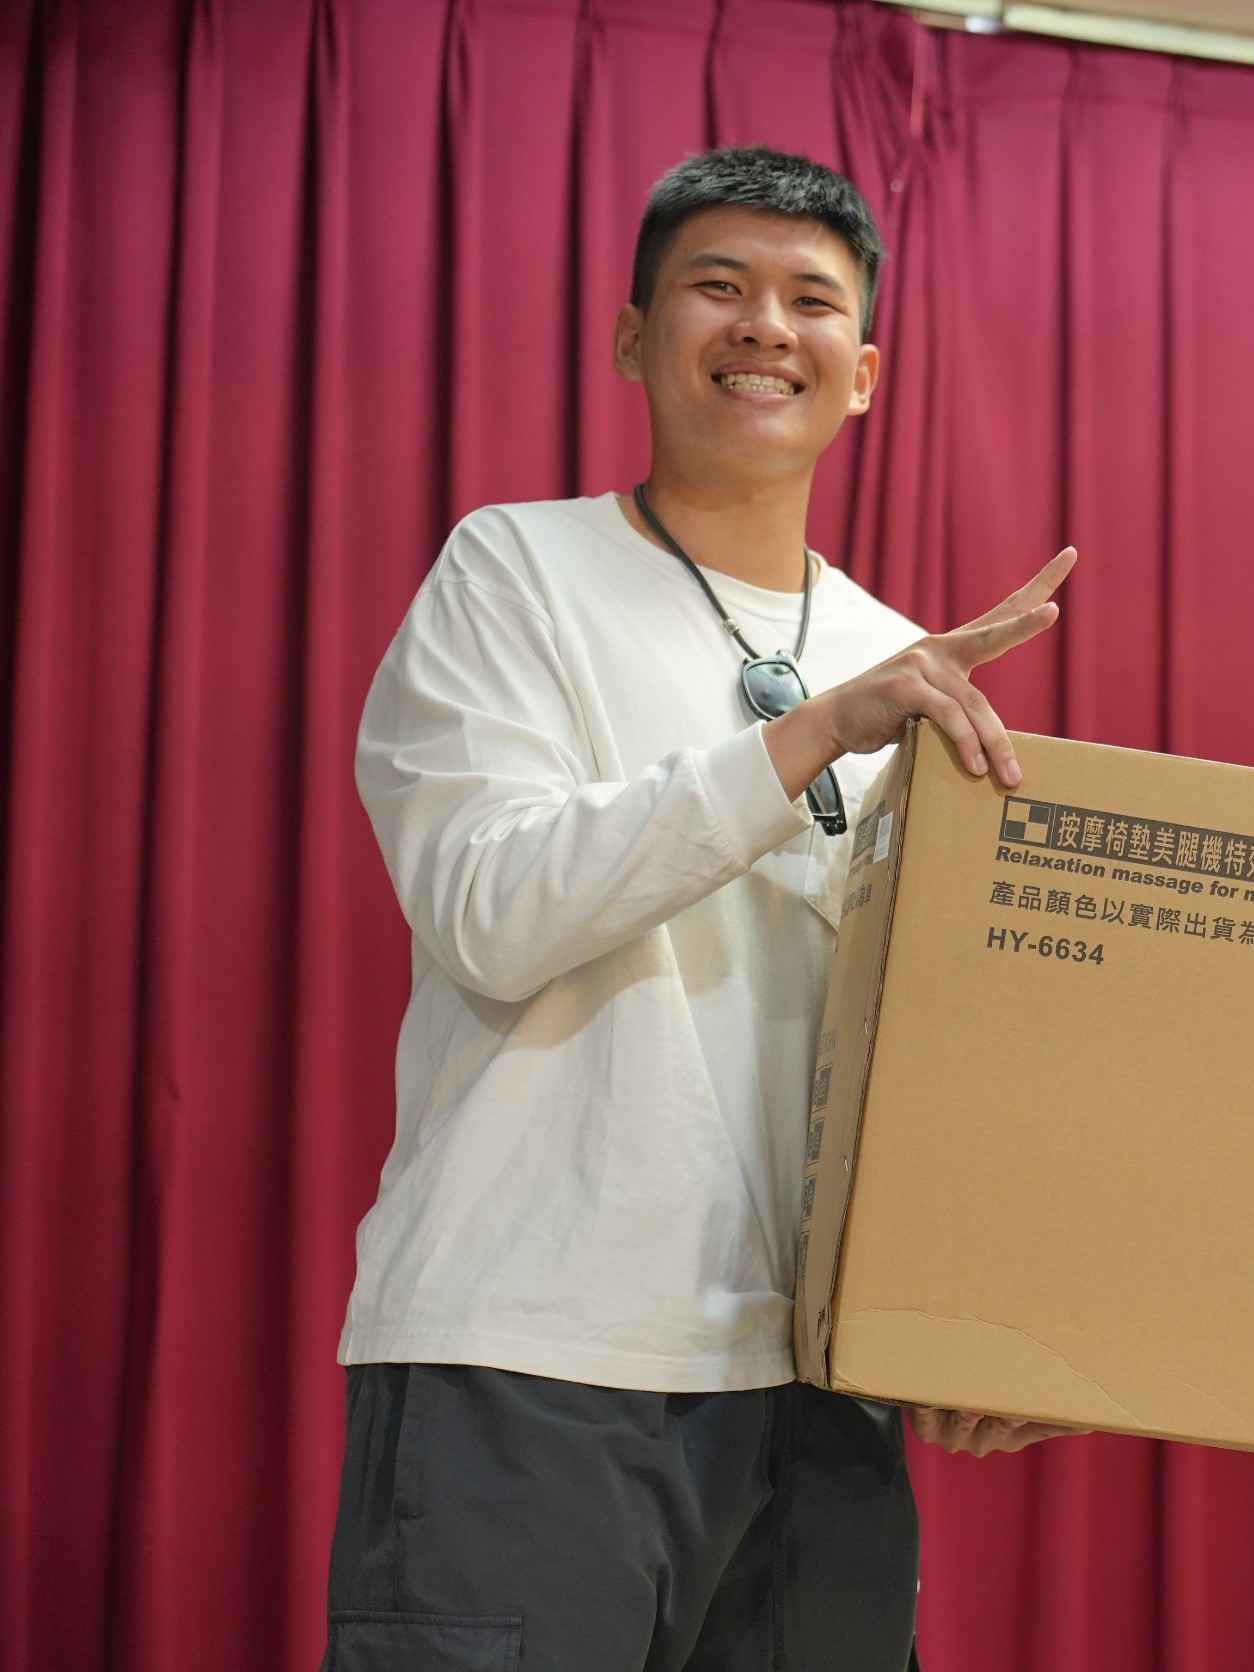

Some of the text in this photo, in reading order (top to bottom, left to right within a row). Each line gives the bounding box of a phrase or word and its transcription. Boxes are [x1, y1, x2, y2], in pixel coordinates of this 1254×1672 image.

[995, 846, 1106, 878] Relaxation
[1111, 868, 1204, 895] massage
[1209, 880, 1240, 899] for
[986, 926, 1105, 966] HY-6634
